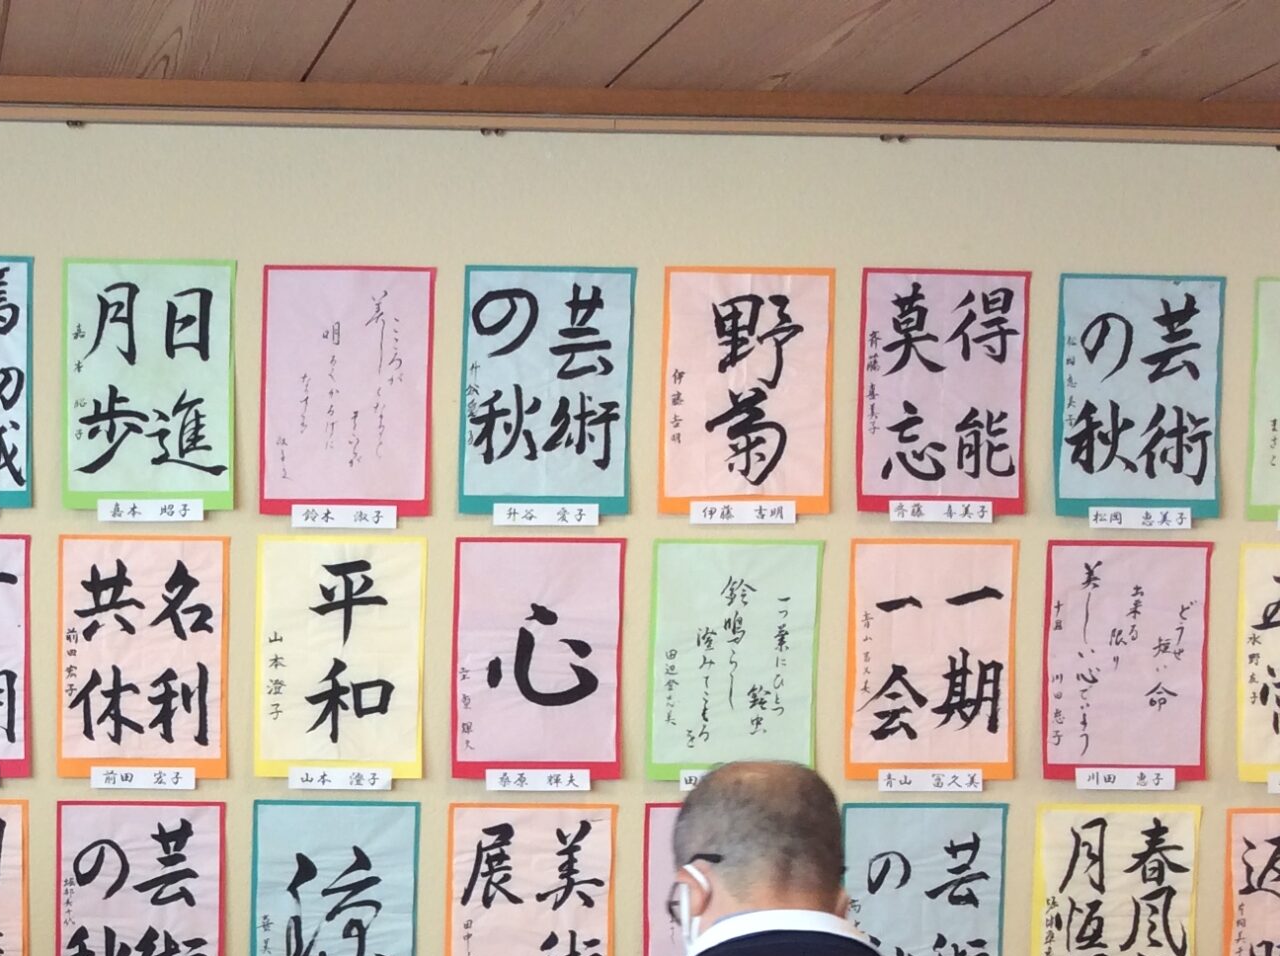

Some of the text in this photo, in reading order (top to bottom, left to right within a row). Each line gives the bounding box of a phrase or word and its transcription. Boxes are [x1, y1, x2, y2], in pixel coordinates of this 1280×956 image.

[74, 282, 148, 474] 月歩
[146, 288, 228, 476] 日進
[470, 288, 541, 464] の秋
[542, 283, 620, 471] 芸術
[704, 294, 804, 486] 野菊
[882, 281, 947, 482] 莫忘
[946, 287, 1020, 479] 得能
[1065, 312, 1140, 475] の秋
[1138, 293, 1213, 486] 芸術
[161, 502, 191, 517] 昭子
[303, 509, 385, 524] 鈴木 淑子
[557, 509, 587, 523] 愛子
[702, 506, 785, 521] 伊藤 吉明
[944, 504, 988, 520] 喜美子
[1141, 510, 1187, 528] 恵美子
[69, 559, 145, 745] 共休
[149, 559, 214, 745] 名利
[305, 559, 396, 744] 平和
[486, 603, 598, 707] 心
[1126, 584, 1144, 641] 出来る
[1174, 600, 1198, 660] どうせ
[267, 631, 286, 721] 山本澄子
[869, 595, 928, 741] 一会
[931, 585, 1004, 734] 一期
[1145, 636, 1178, 711] 短い命
[103, 769, 184, 785] 前田 宏子
[301, 772, 381, 788] 山本 澄子
[547, 772, 580, 788] 輝夫
[882, 774, 912, 789] 青山
[1087, 771, 1164, 788] 川田 恵子
[461, 822, 524, 909] 展
